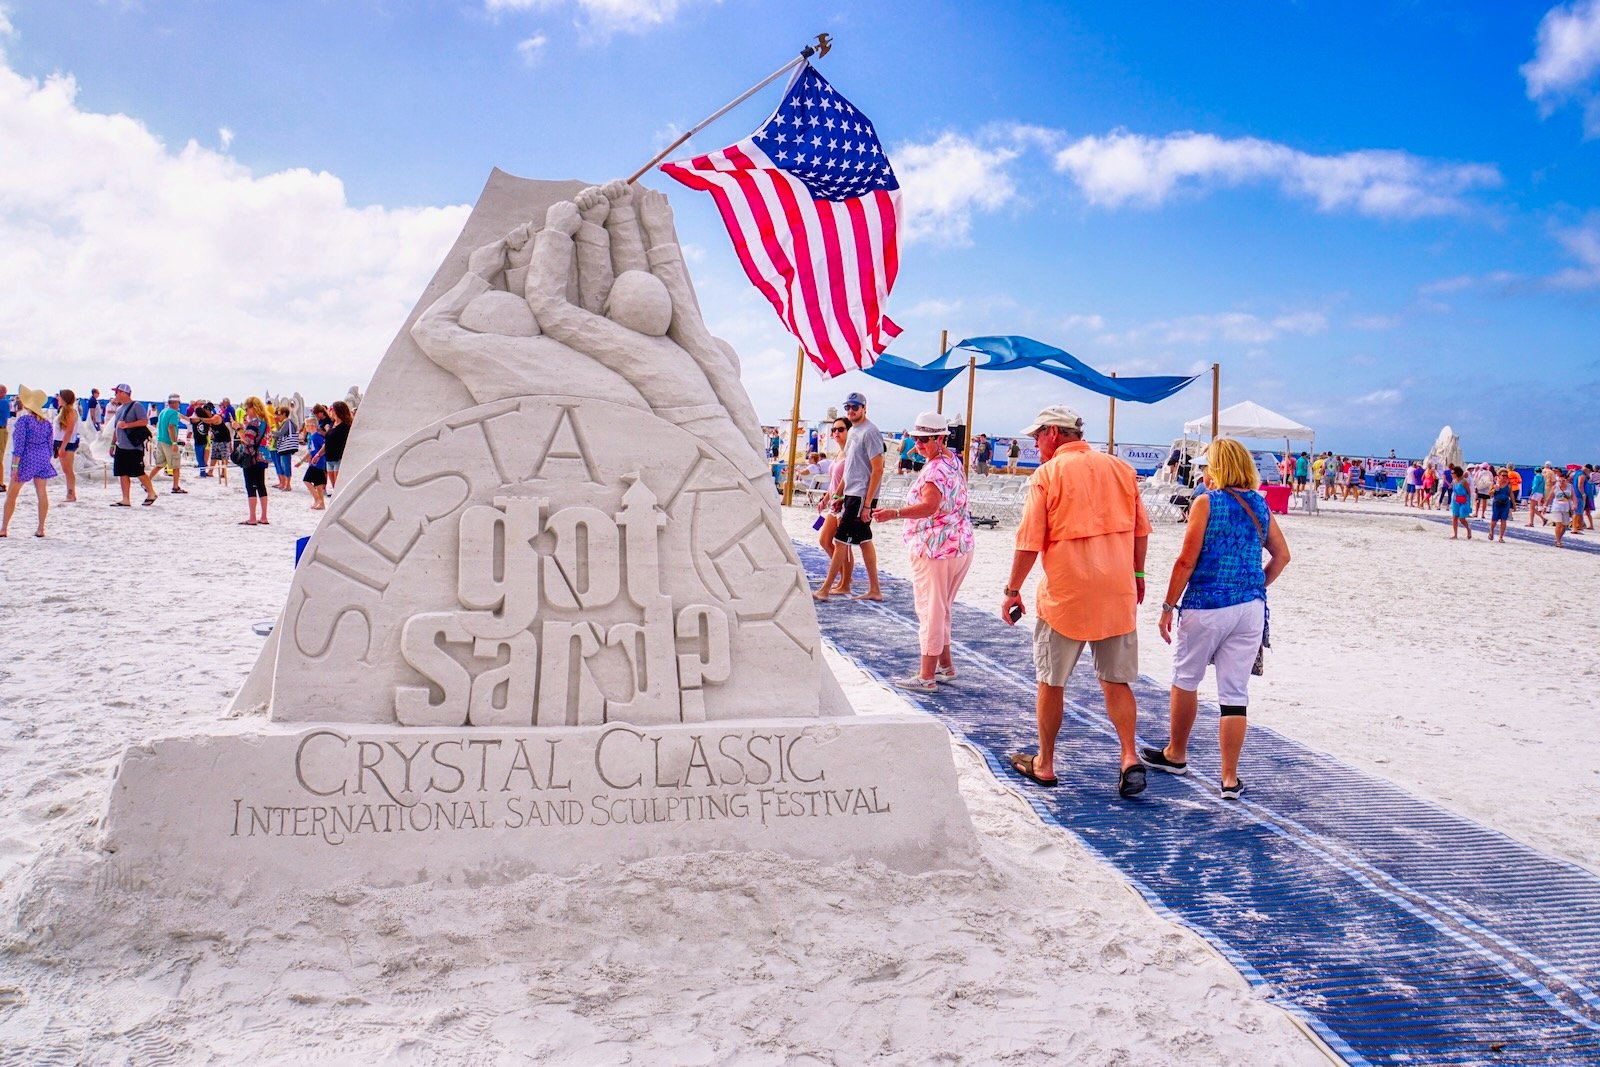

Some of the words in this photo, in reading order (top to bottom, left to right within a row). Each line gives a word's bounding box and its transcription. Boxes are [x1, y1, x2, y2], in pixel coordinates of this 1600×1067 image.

[1128, 450, 1160, 459] DAMEX
[294, 403, 606, 667] SIESTA
[663, 444, 816, 661] KEY
[457, 470, 668, 639] got
[295, 731, 571, 807] CRYSTAL
[594, 727, 825, 790] CLASSIC
[230, 799, 494, 845] INTERNATIONAL
[504, 796, 584, 829] SAND
[591, 793, 750, 826] SCULPTING
[757, 786, 891, 825] FESTIVAL
